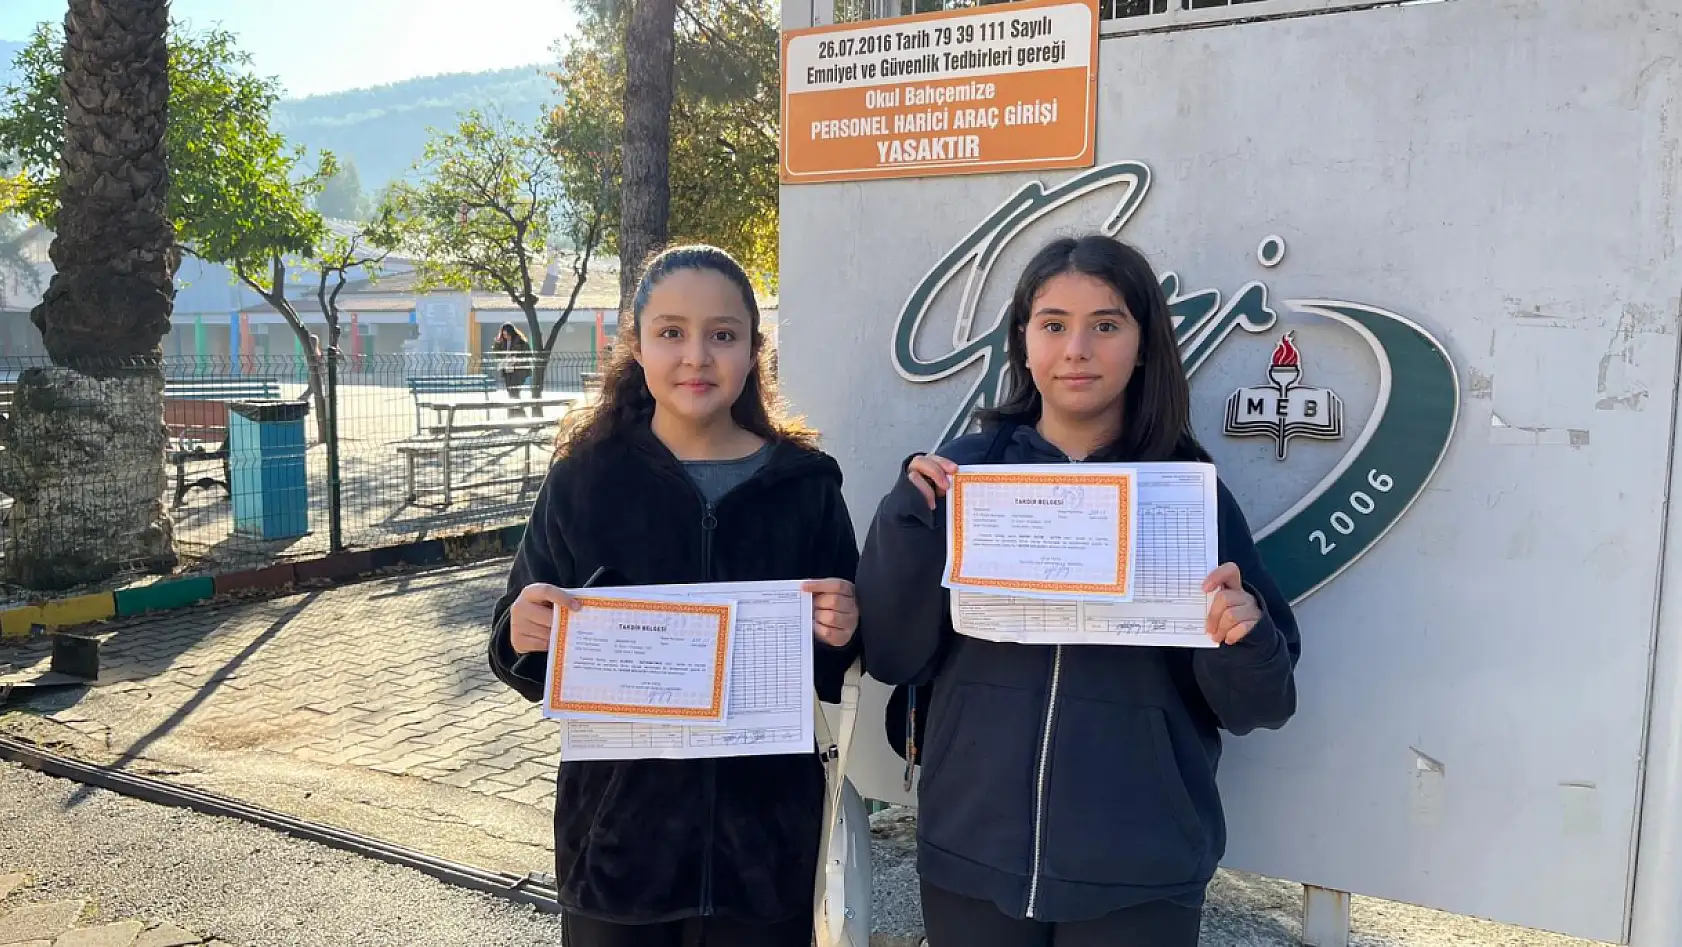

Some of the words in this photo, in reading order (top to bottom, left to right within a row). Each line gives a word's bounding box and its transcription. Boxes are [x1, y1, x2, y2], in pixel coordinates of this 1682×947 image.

[818, 34, 892, 59] 26.07.2016
[896, 27, 930, 52] Tarih
[934, 28, 952, 46] 79
[956, 25, 974, 44] 39
[979, 21, 1006, 42] 111
[1010, 15, 1052, 40] Sayılı
[807, 62, 858, 85] Emniyet
[861, 63, 877, 80] ve
[880, 54, 940, 78] Güvenlik
[944, 47, 1012, 70] Tedbirleri
[1017, 40, 1066, 67] gereği
[865, 88, 900, 110] Okul
[905, 81, 996, 107] Bahçemize
[811, 118, 889, 141] PERSONEL
[894, 107, 949, 134] HARİCİ
[953, 108, 1000, 131] ARAÇ
[1004, 98, 1059, 126] GİRİŞİ
[876, 134, 981, 163] YASAKTIR
[1308, 468, 1395, 556] 2006
